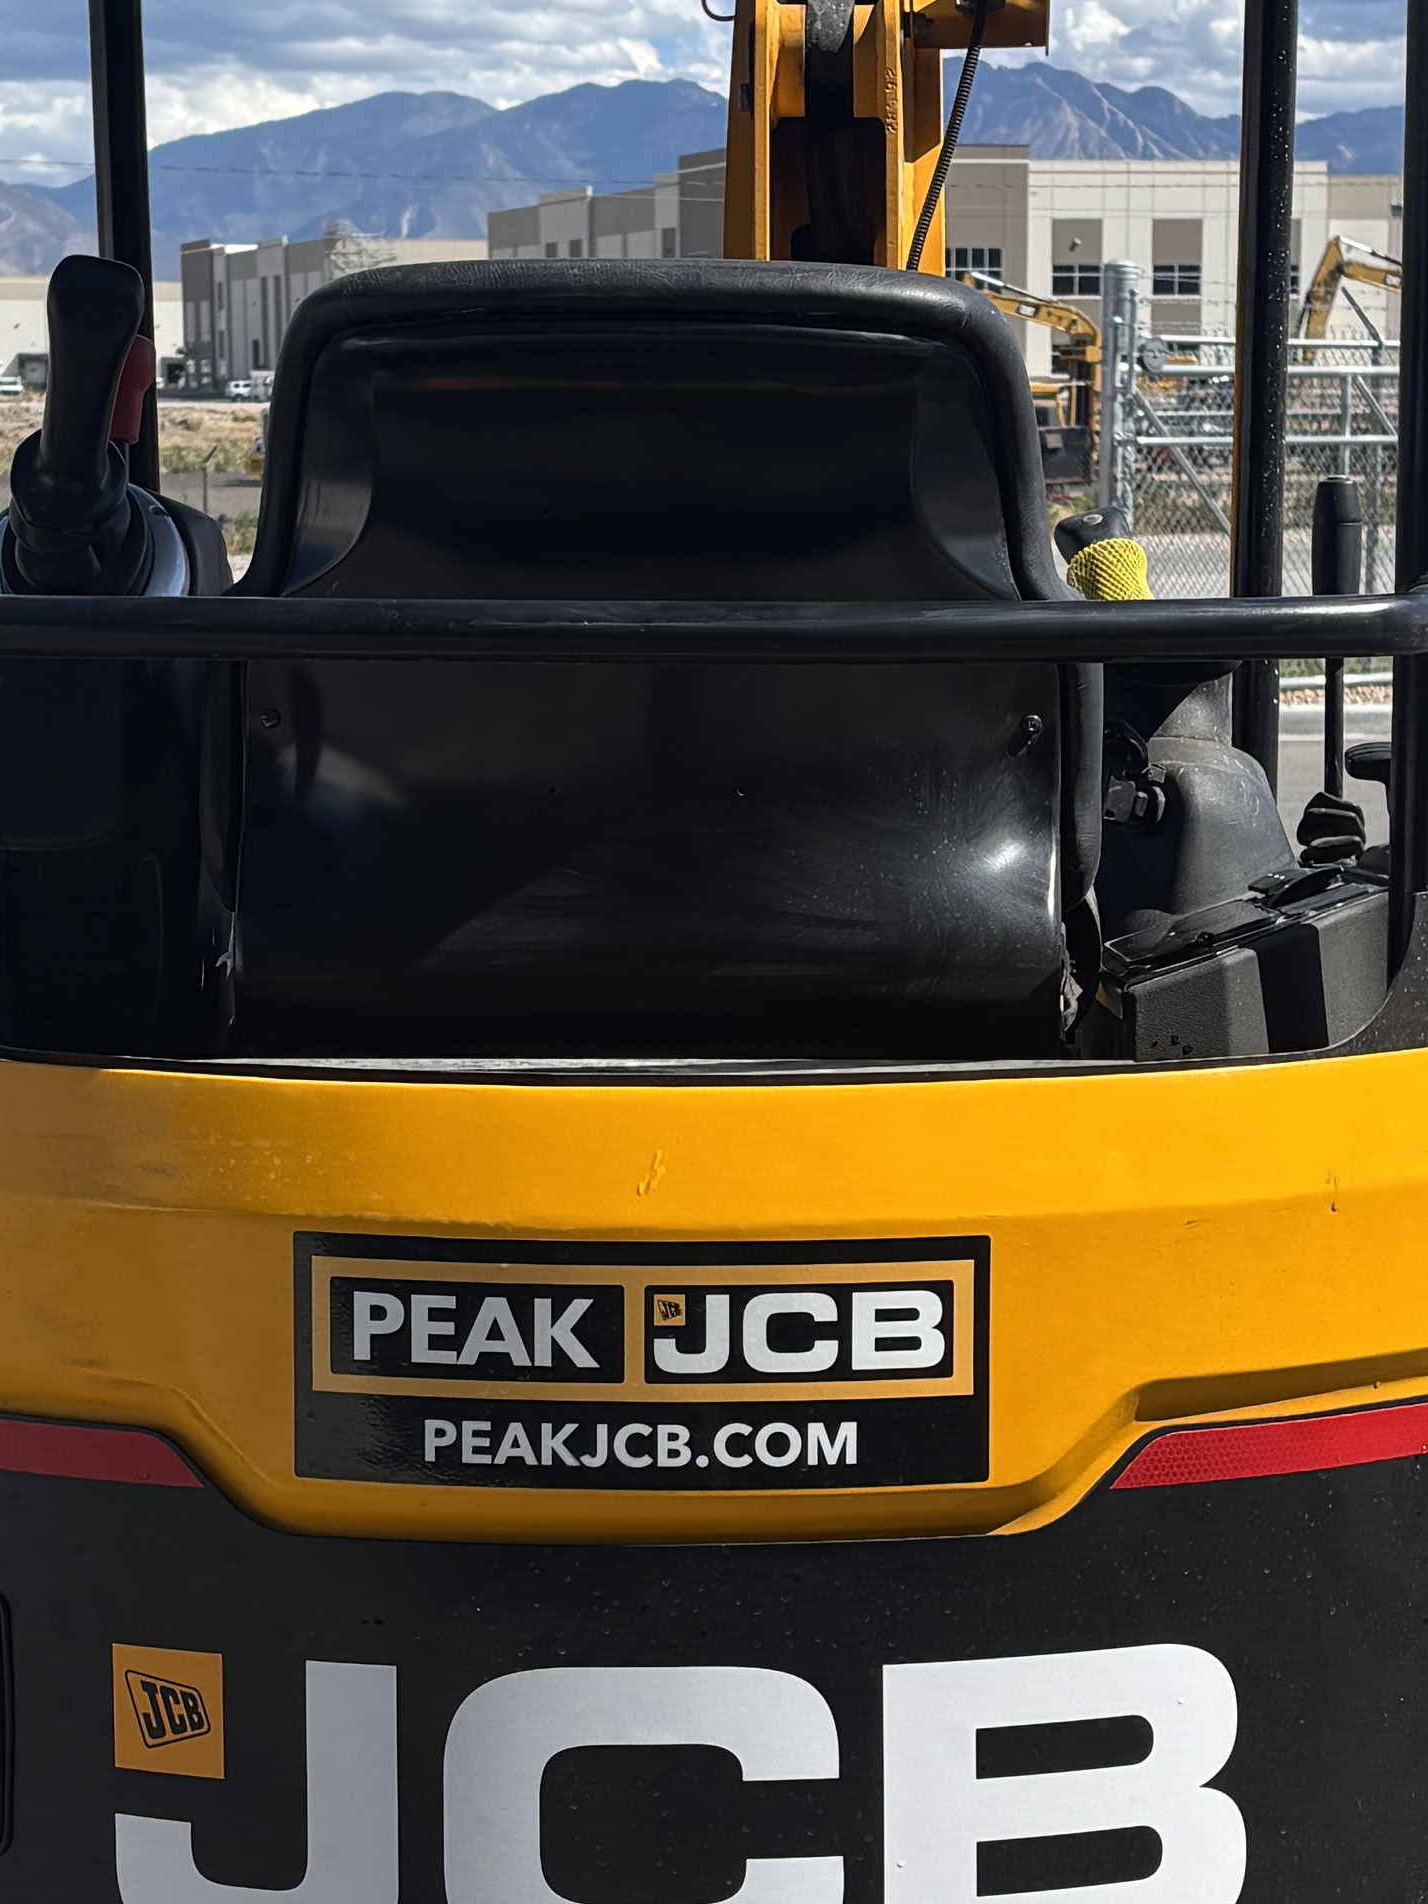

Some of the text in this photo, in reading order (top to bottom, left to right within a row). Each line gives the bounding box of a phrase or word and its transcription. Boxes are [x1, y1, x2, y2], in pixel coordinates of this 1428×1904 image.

[353, 1289, 946, 1375] PEAK JCB
[423, 1420, 859, 1469] PEAKJCB.COM
[141, 1679, 205, 1740] JCB
